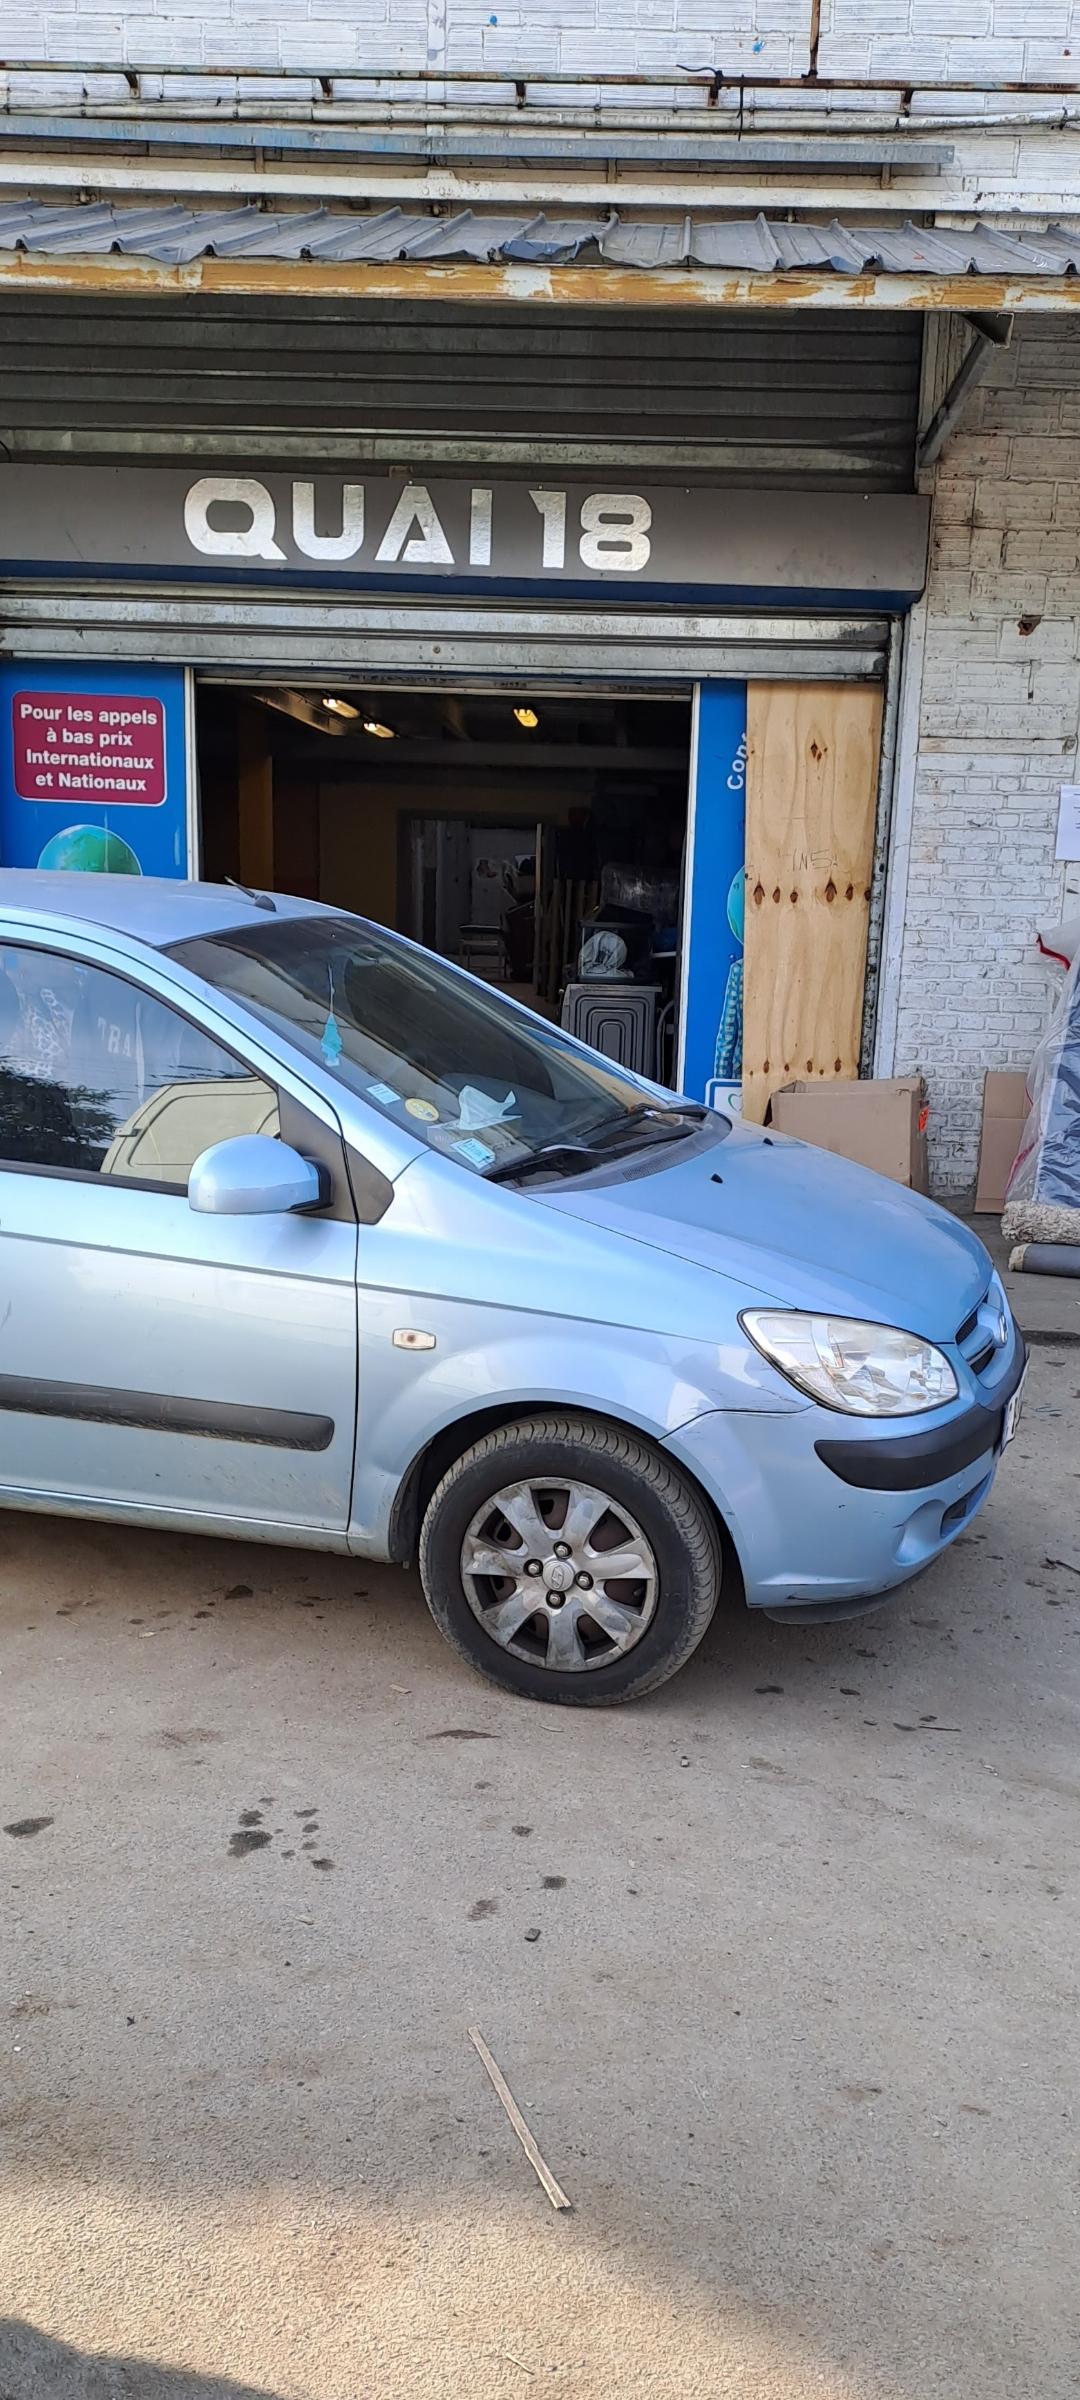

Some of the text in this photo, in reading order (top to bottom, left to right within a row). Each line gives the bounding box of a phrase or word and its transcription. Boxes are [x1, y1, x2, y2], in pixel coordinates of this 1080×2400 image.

[184, 477, 652, 572] QUAI 18
[20, 703, 157, 726] Pour les appels
[46, 727, 133, 748] à bas prix
[26, 749, 154, 770] Internationaux
[35, 772, 147, 791] et Nationaux
